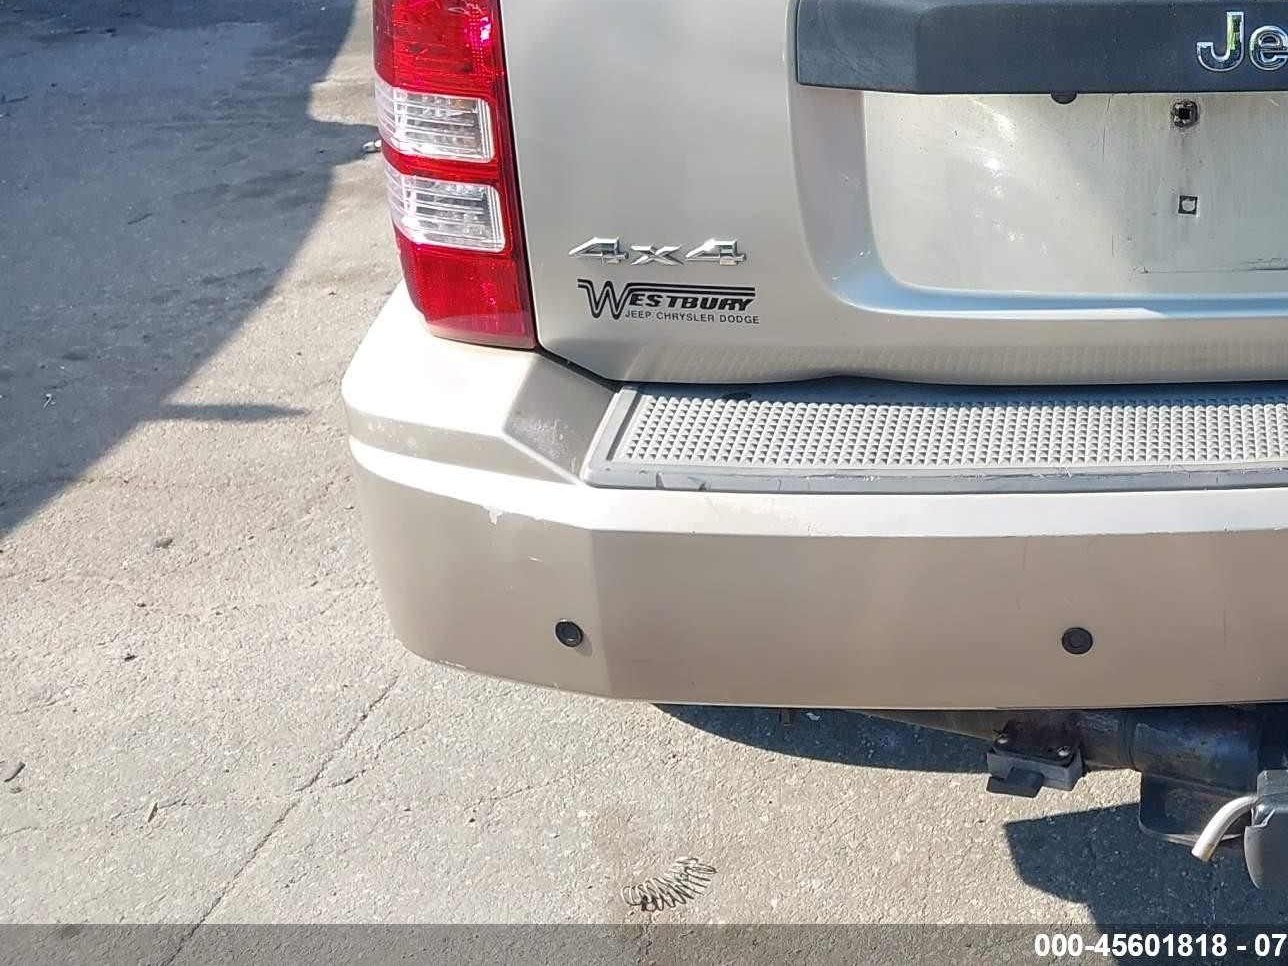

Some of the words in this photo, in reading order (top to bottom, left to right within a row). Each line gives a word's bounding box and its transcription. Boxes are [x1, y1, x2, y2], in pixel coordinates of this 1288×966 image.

[566, 236, 748, 266] 4x4
[577, 278, 755, 320] WESTBURY
[624, 309, 652, 320] JEEP
[656, 311, 715, 323] CHRYSLER
[719, 314, 760, 325] DODGE
